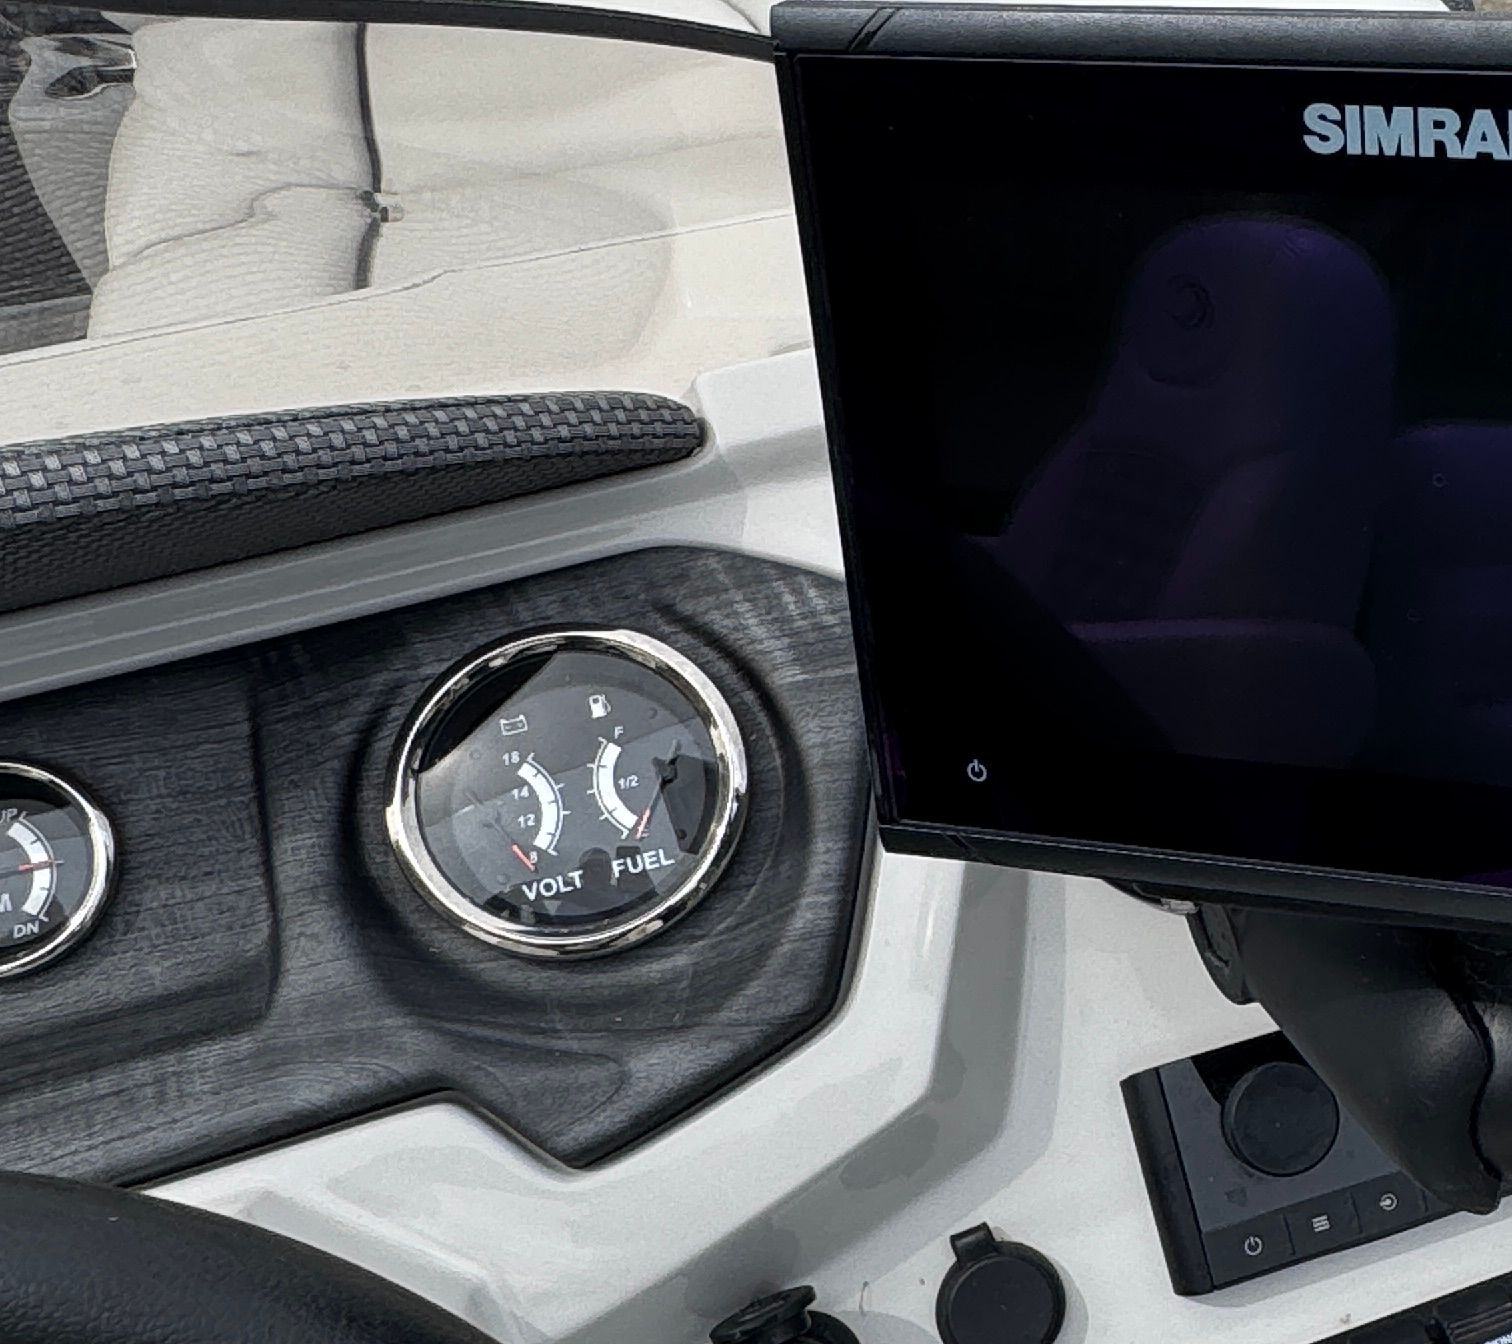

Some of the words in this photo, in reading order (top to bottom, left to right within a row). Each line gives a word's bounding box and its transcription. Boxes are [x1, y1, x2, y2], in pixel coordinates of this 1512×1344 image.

[614, 726, 624, 739] F
[502, 751, 520, 766] 18
[618, 774, 640, 790] 1/2
[512, 785, 530, 801] 14
[517, 814, 536, 829] 12
[611, 849, 675, 878] FUEL
[522, 870, 583, 901] VOLT
[13, 921, 39, 938] DN
